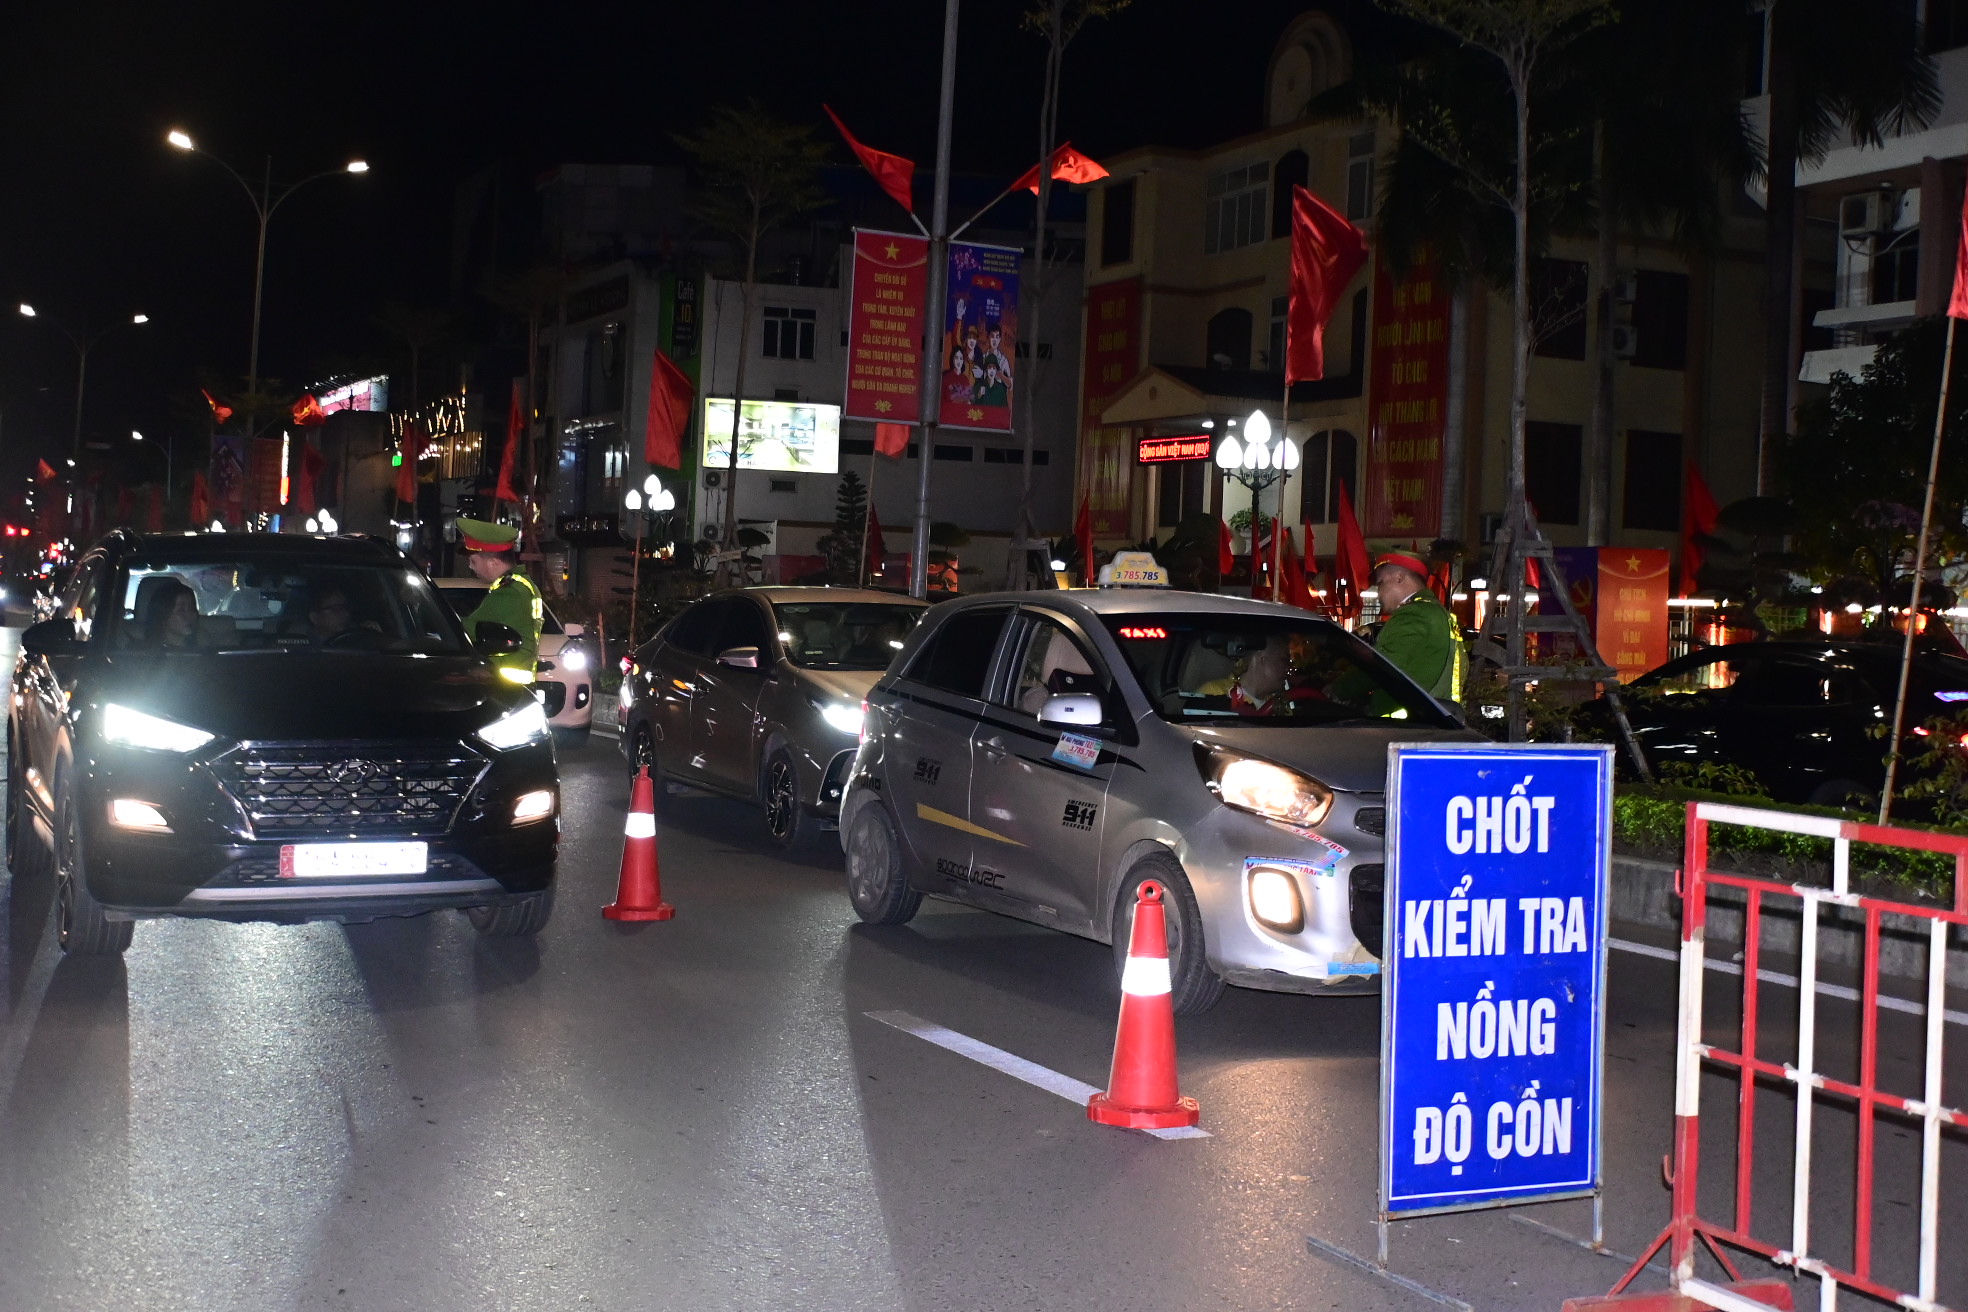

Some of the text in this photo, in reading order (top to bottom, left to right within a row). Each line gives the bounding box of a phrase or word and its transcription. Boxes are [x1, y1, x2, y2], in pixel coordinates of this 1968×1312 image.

[1140, 444, 1155, 459] CỘNG
[1168, 442, 1180, 457] VIỆT
[1181, 443, 1194, 455] NAM
[1116, 571, 1159, 580] 3.785.785
[1120, 627, 1166, 638] TAXI
[1446, 775, 1555, 855] CHỐT
[1404, 874, 1587, 958] KIỂM TRA
[1436, 980, 1556, 1061] NỒNG
[1413, 1079, 1572, 1176] ĐỘ CỒN
